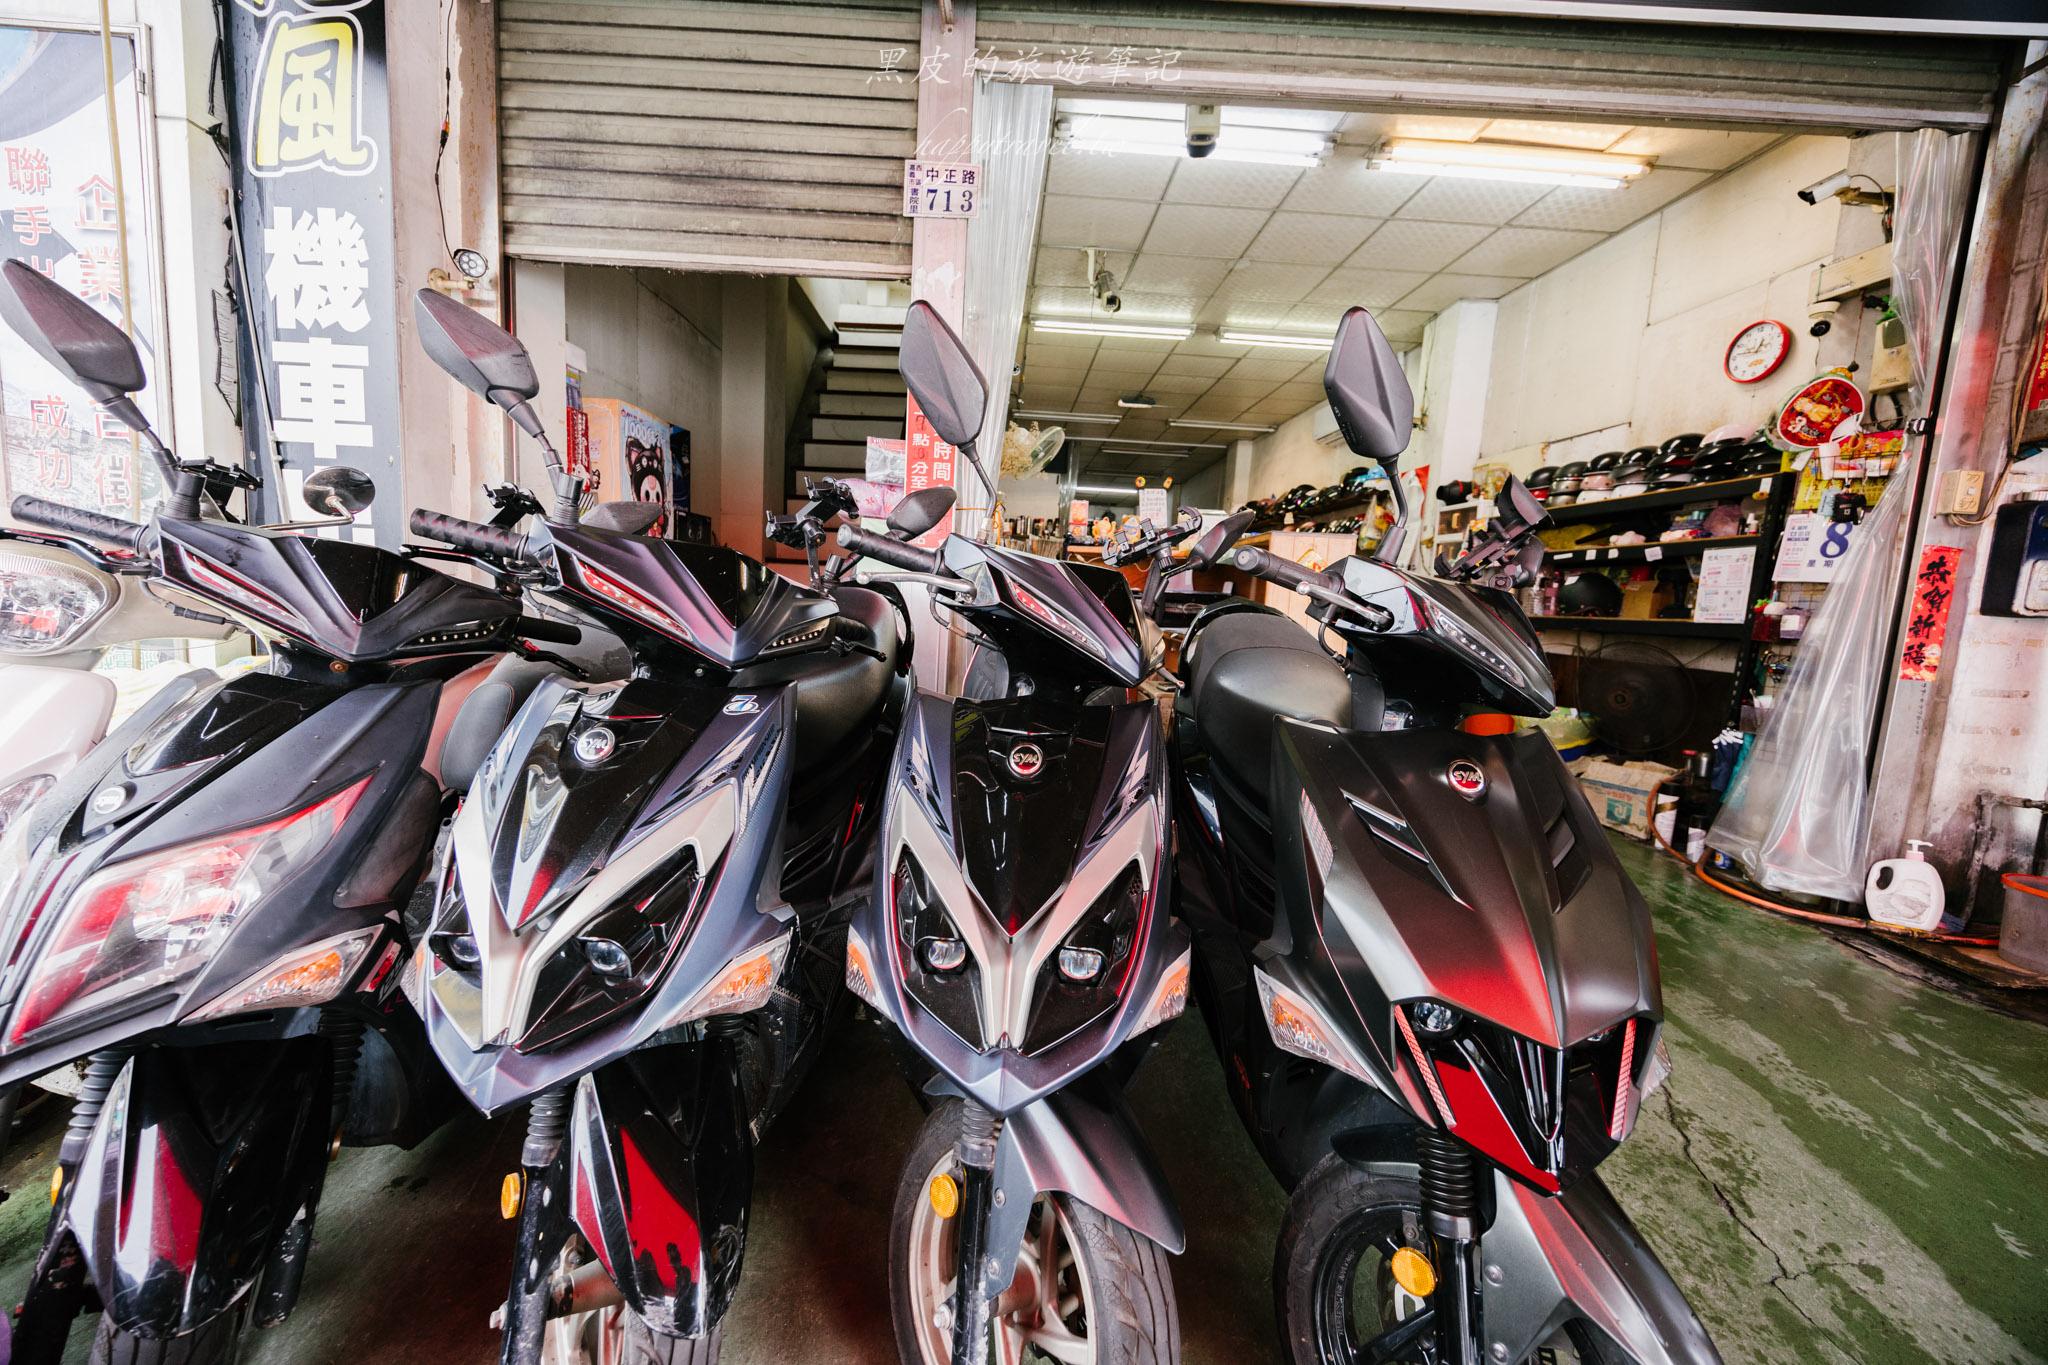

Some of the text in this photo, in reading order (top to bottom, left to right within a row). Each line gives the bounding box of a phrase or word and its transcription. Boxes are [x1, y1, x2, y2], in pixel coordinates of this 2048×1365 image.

[245, 0, 378, 177] 風
[926, 167, 975, 185] 中正路
[926, 188, 973, 212] 713
[1819, 521, 1853, 559] 8
[1903, 555, 1951, 665] 恭賀新禧
